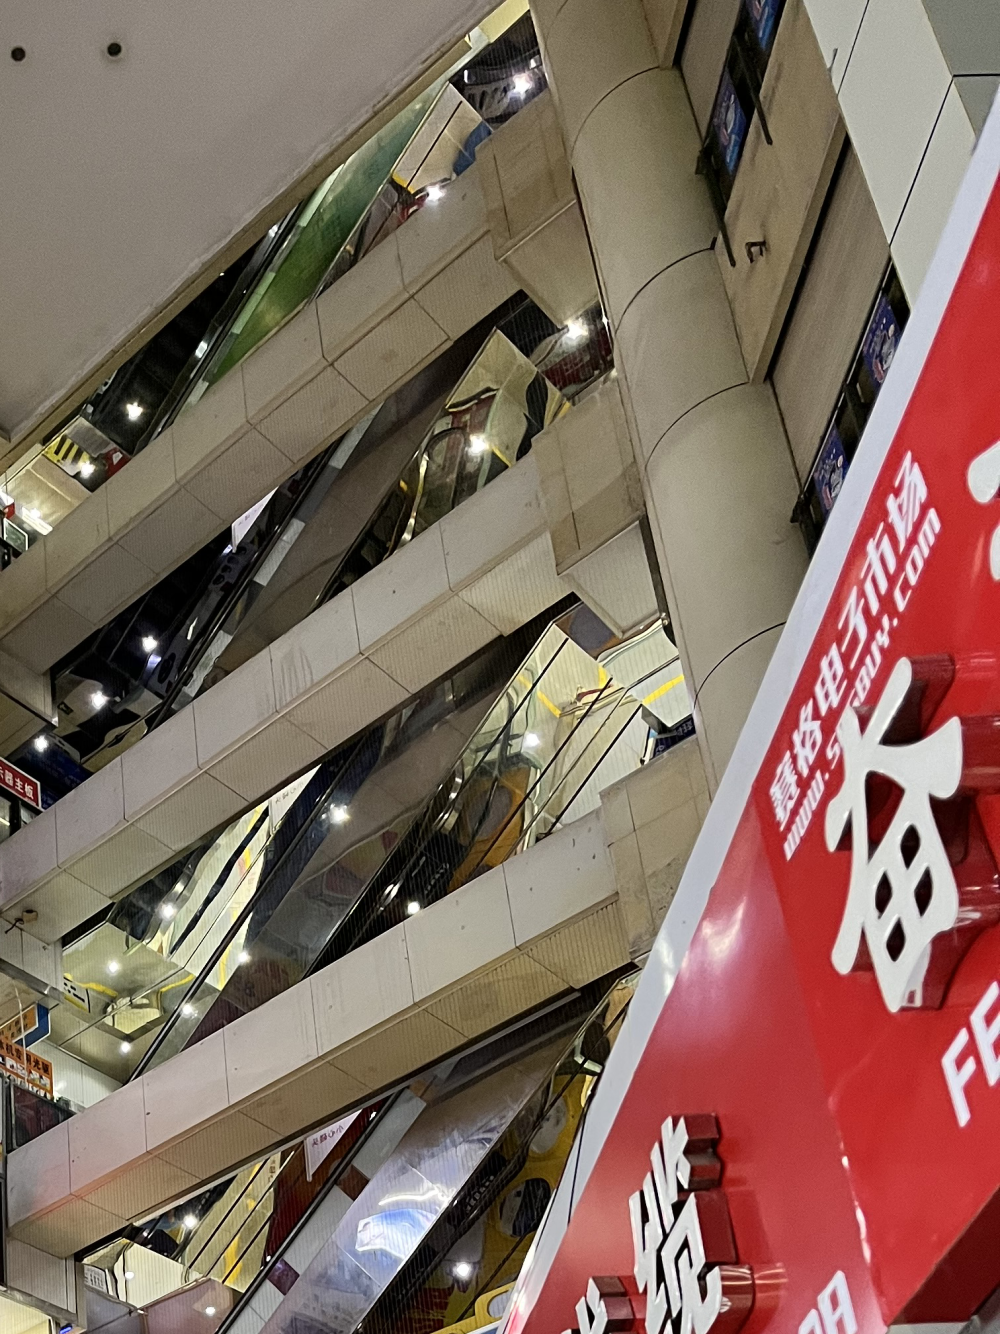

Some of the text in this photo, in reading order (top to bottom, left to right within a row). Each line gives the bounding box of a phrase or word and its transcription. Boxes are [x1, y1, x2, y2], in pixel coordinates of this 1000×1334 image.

[769, 450, 929, 833] 赛格电子市场
[782, 506, 942, 862] WWW.SBUY.COM
